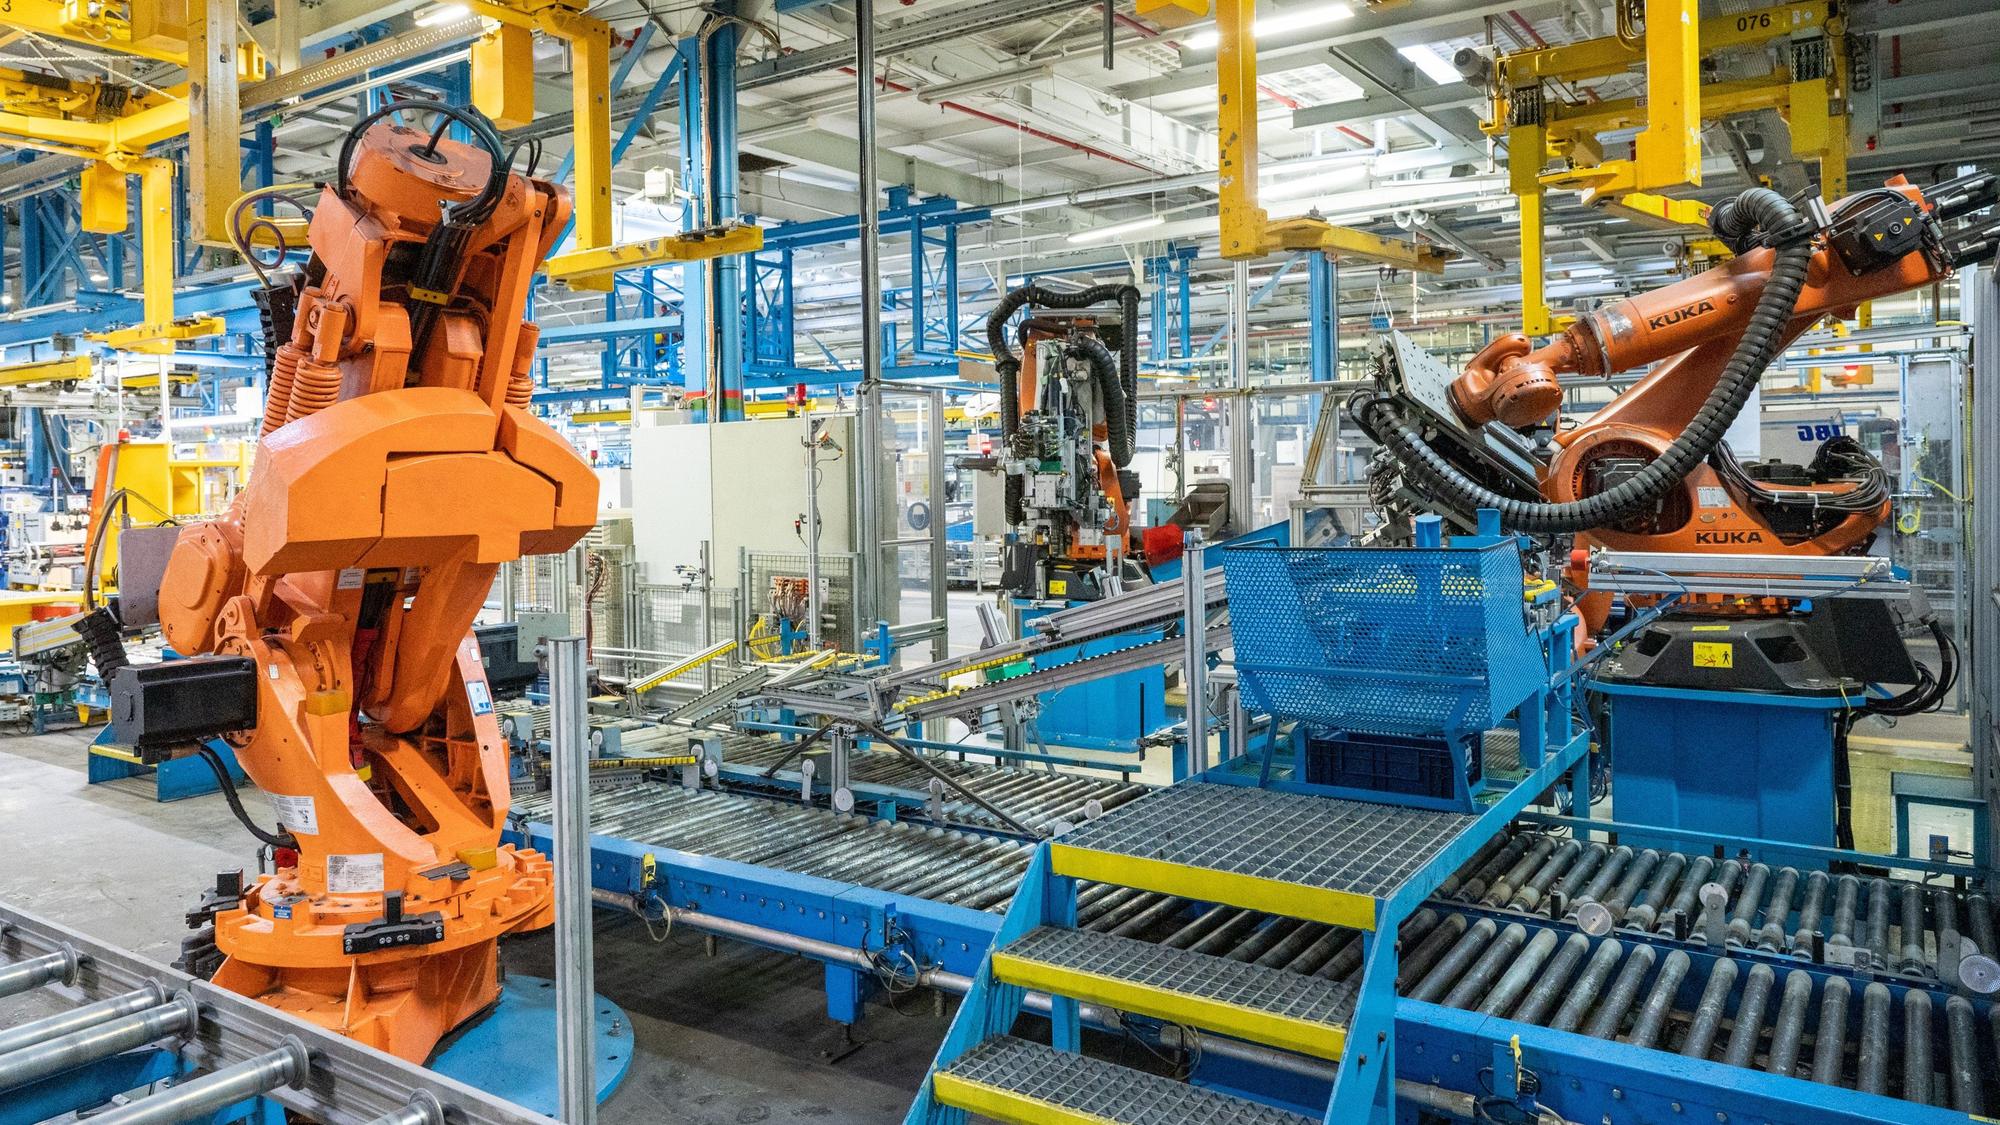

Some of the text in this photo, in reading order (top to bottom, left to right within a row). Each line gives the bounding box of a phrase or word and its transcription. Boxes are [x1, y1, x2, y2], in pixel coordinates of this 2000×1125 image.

[1737, 12, 1771, 32] 076
[1649, 301, 1715, 331] KUKA
[1695, 531, 1763, 545] KUKA
